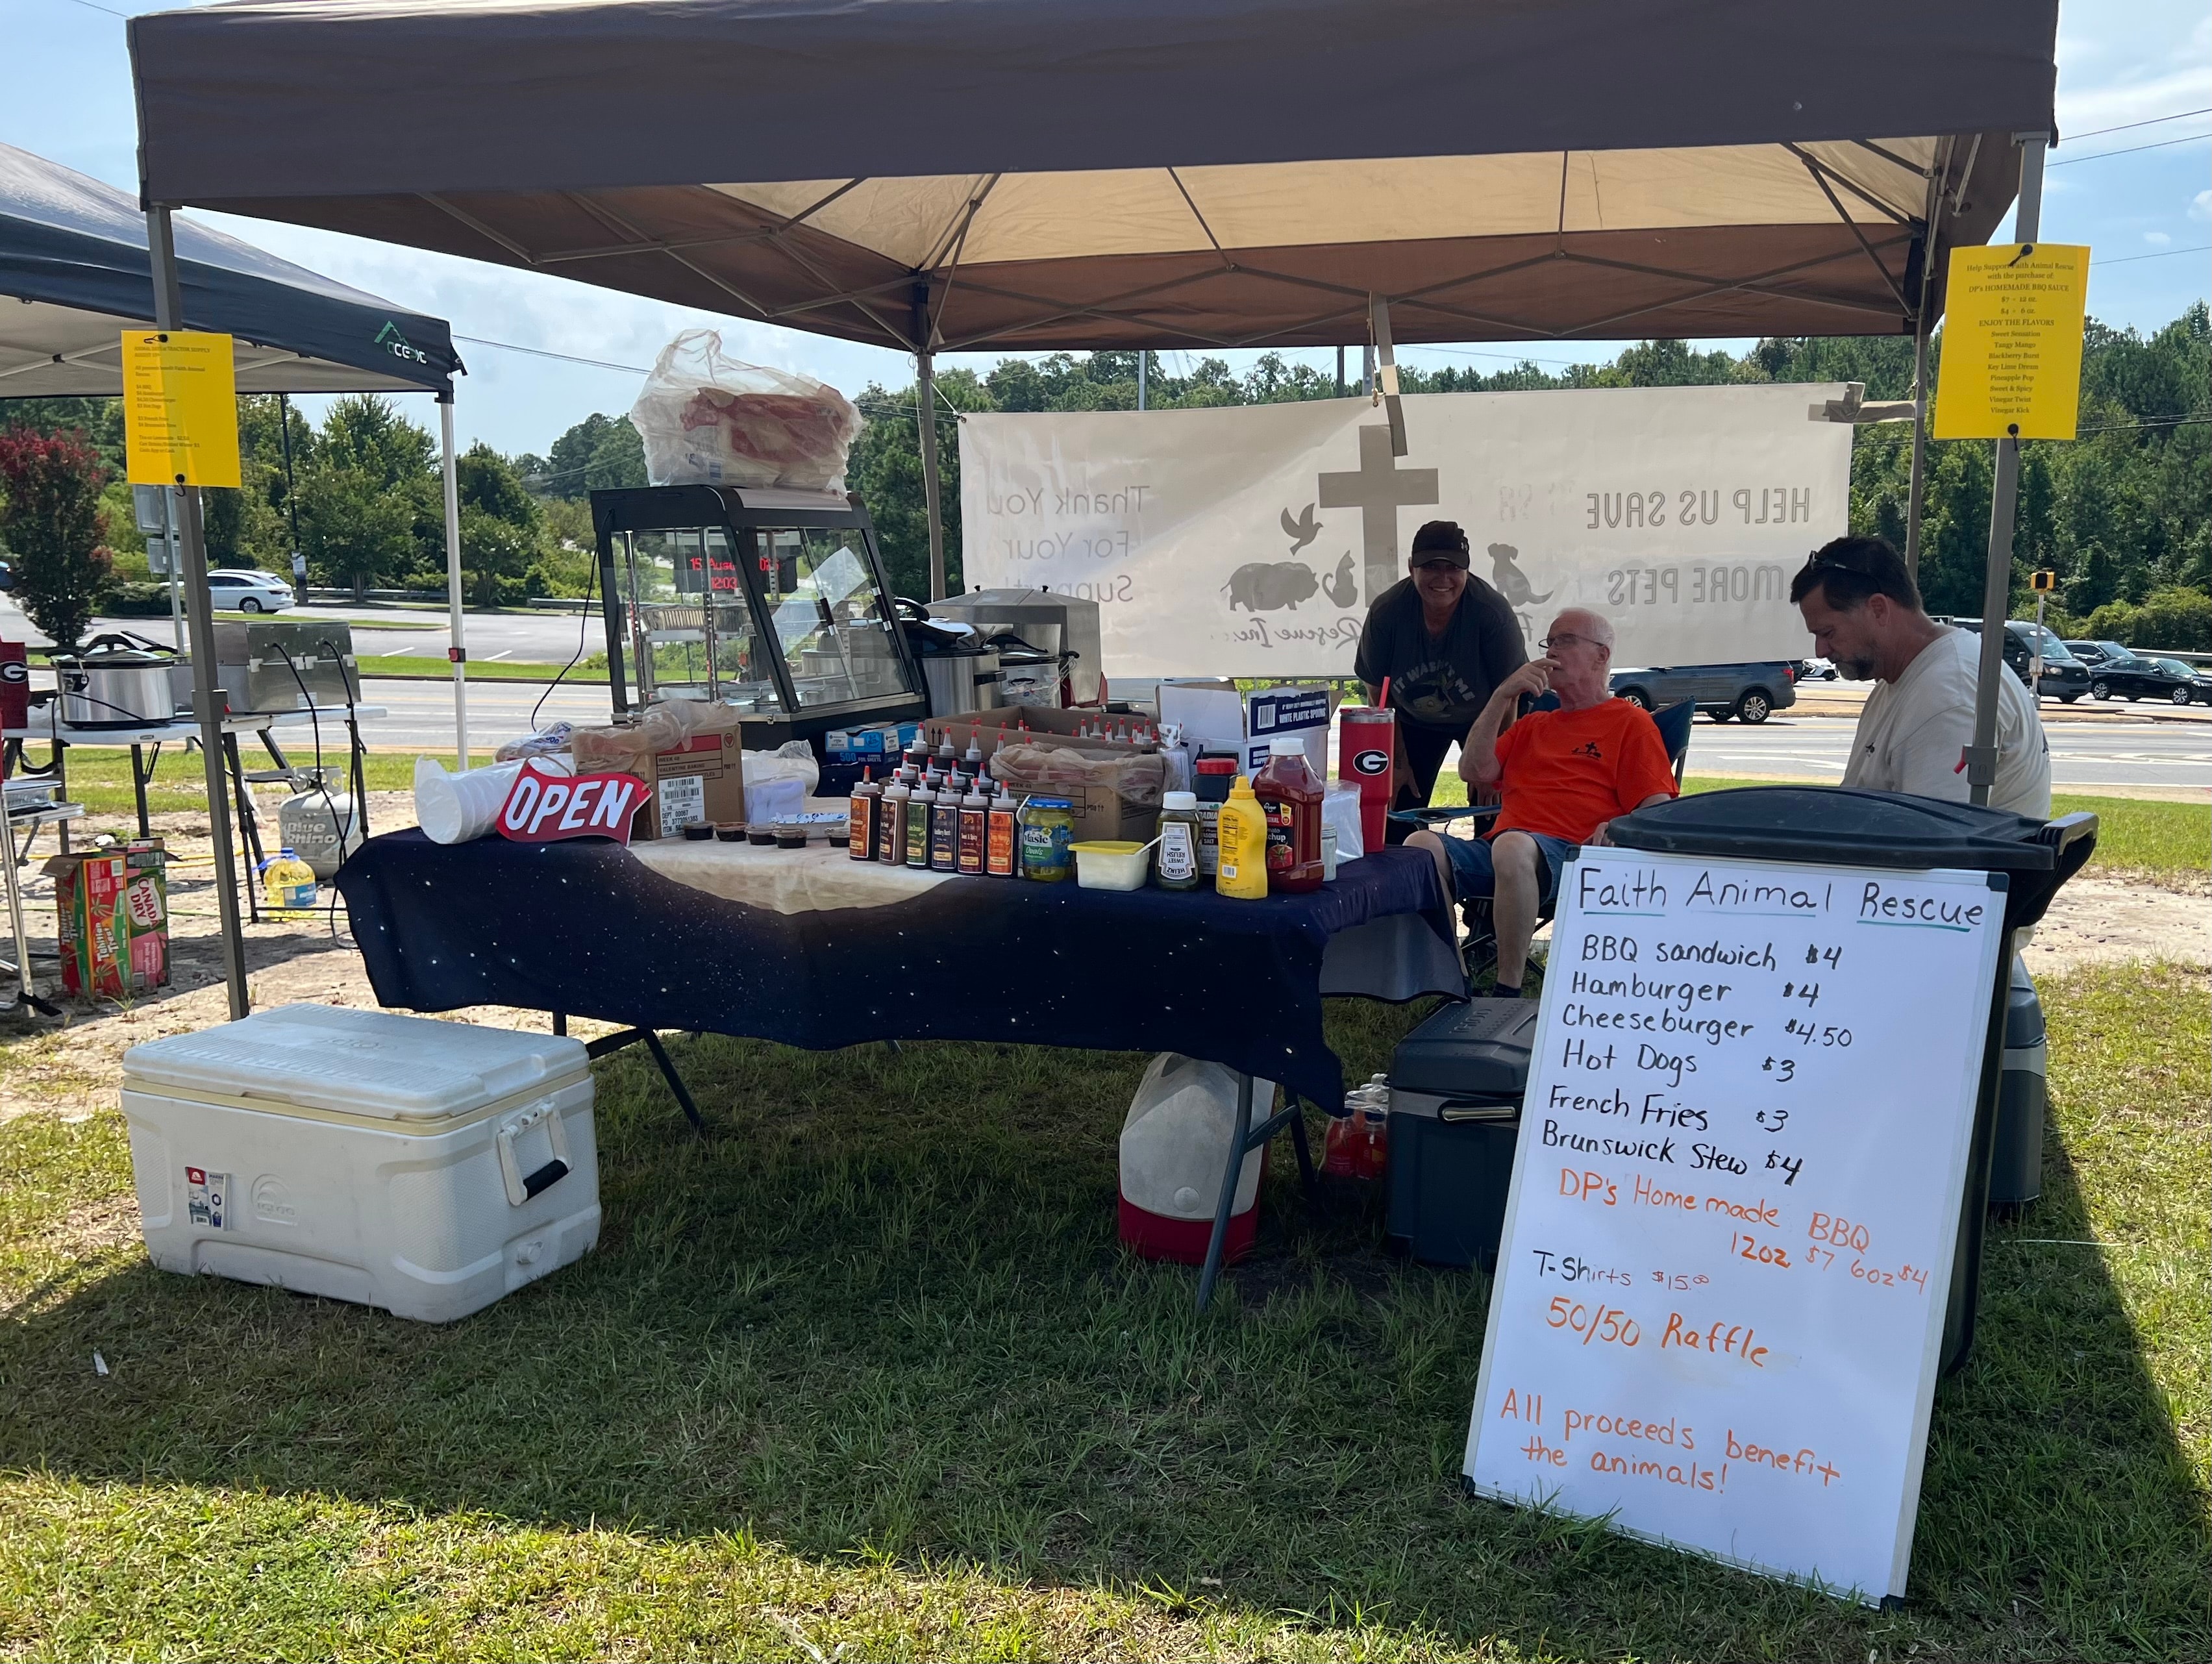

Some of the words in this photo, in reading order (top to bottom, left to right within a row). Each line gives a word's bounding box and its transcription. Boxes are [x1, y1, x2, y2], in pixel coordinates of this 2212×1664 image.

[2015, 271, 2045, 280] purchase
[2055, 262, 2075, 271] Rescue
[1984, 284, 2030, 292] HOMEMADE
[2032, 284, 2047, 292] BBQ
[2048, 284, 2070, 292] SAUCE
[1393, 677, 1406, 694] IT
[1455, 678, 1476, 701] ME
[1293, 710, 1310, 722] PLASTIC
[1310, 707, 1326, 719] SPOONS
[658, 764, 686, 773] VALENTINE
[839, 752, 857, 762] 500
[504, 775, 634, 834] OPEN
[288, 822, 327, 834] Blue
[289, 832, 337, 845] Rhino
[1024, 833, 1049, 844] Vlasic
[1267, 833, 1286, 843] chup
[1026, 846, 1044, 856] Ovals
[130, 893, 147, 919] DRY
[137, 877, 160, 928] CANADA
[1580, 868, 1667, 908] Faith
[1686, 871, 1831, 910] Animal
[1861, 882, 1984, 925] Rescue
[95, 922, 110, 962] Tahitian
[104, 927, 119, 954] Treat
[1582, 934, 1638, 963] BBQ
[1656, 941, 1776, 971] sandwich
[1806, 945, 1843, 971] $4
[1572, 972, 1732, 1010] Hamburger
[1783, 982, 1819, 1008] $4
[1562, 1005, 1754, 1045] Cheeseburger
[1785, 1018, 1852, 1048] $4.50
[1563, 1039, 1617, 1071] Hot
[1638, 1043, 1698, 1087] Dogs
[1761, 1056, 1796, 1082] $3
[1549, 1085, 1630, 1119] French
[1641, 1094, 1708, 1132] Fries
[1756, 1110, 1789, 1132] $3
[1543, 1120, 1675, 1164] Brunswick
[1691, 1141, 1748, 1176] Stew
[1765, 1151, 1804, 1187] $4
[1560, 1168, 1617, 1206] DP's
[1809, 1211, 1870, 1255] BBQ
[1534, 1249, 1632, 1287] T-Shirts
[1731, 1232, 1791, 1269] 12oz
[1806, 1246, 1835, 1271] $7
[1850, 1258, 1895, 1287] 6oz
[1897, 1263, 1929, 1295] $4
[1546, 1297, 1641, 1347] 50/50
[1661, 1312, 1770, 1368] Raffle
[1501, 1387, 1542, 1426] All
[1565, 1406, 1695, 1450] proceeds
[1726, 1428, 1841, 1487] benefit
[1521, 1435, 1568, 1468] the
[1591, 1450, 1727, 1495] animals!
